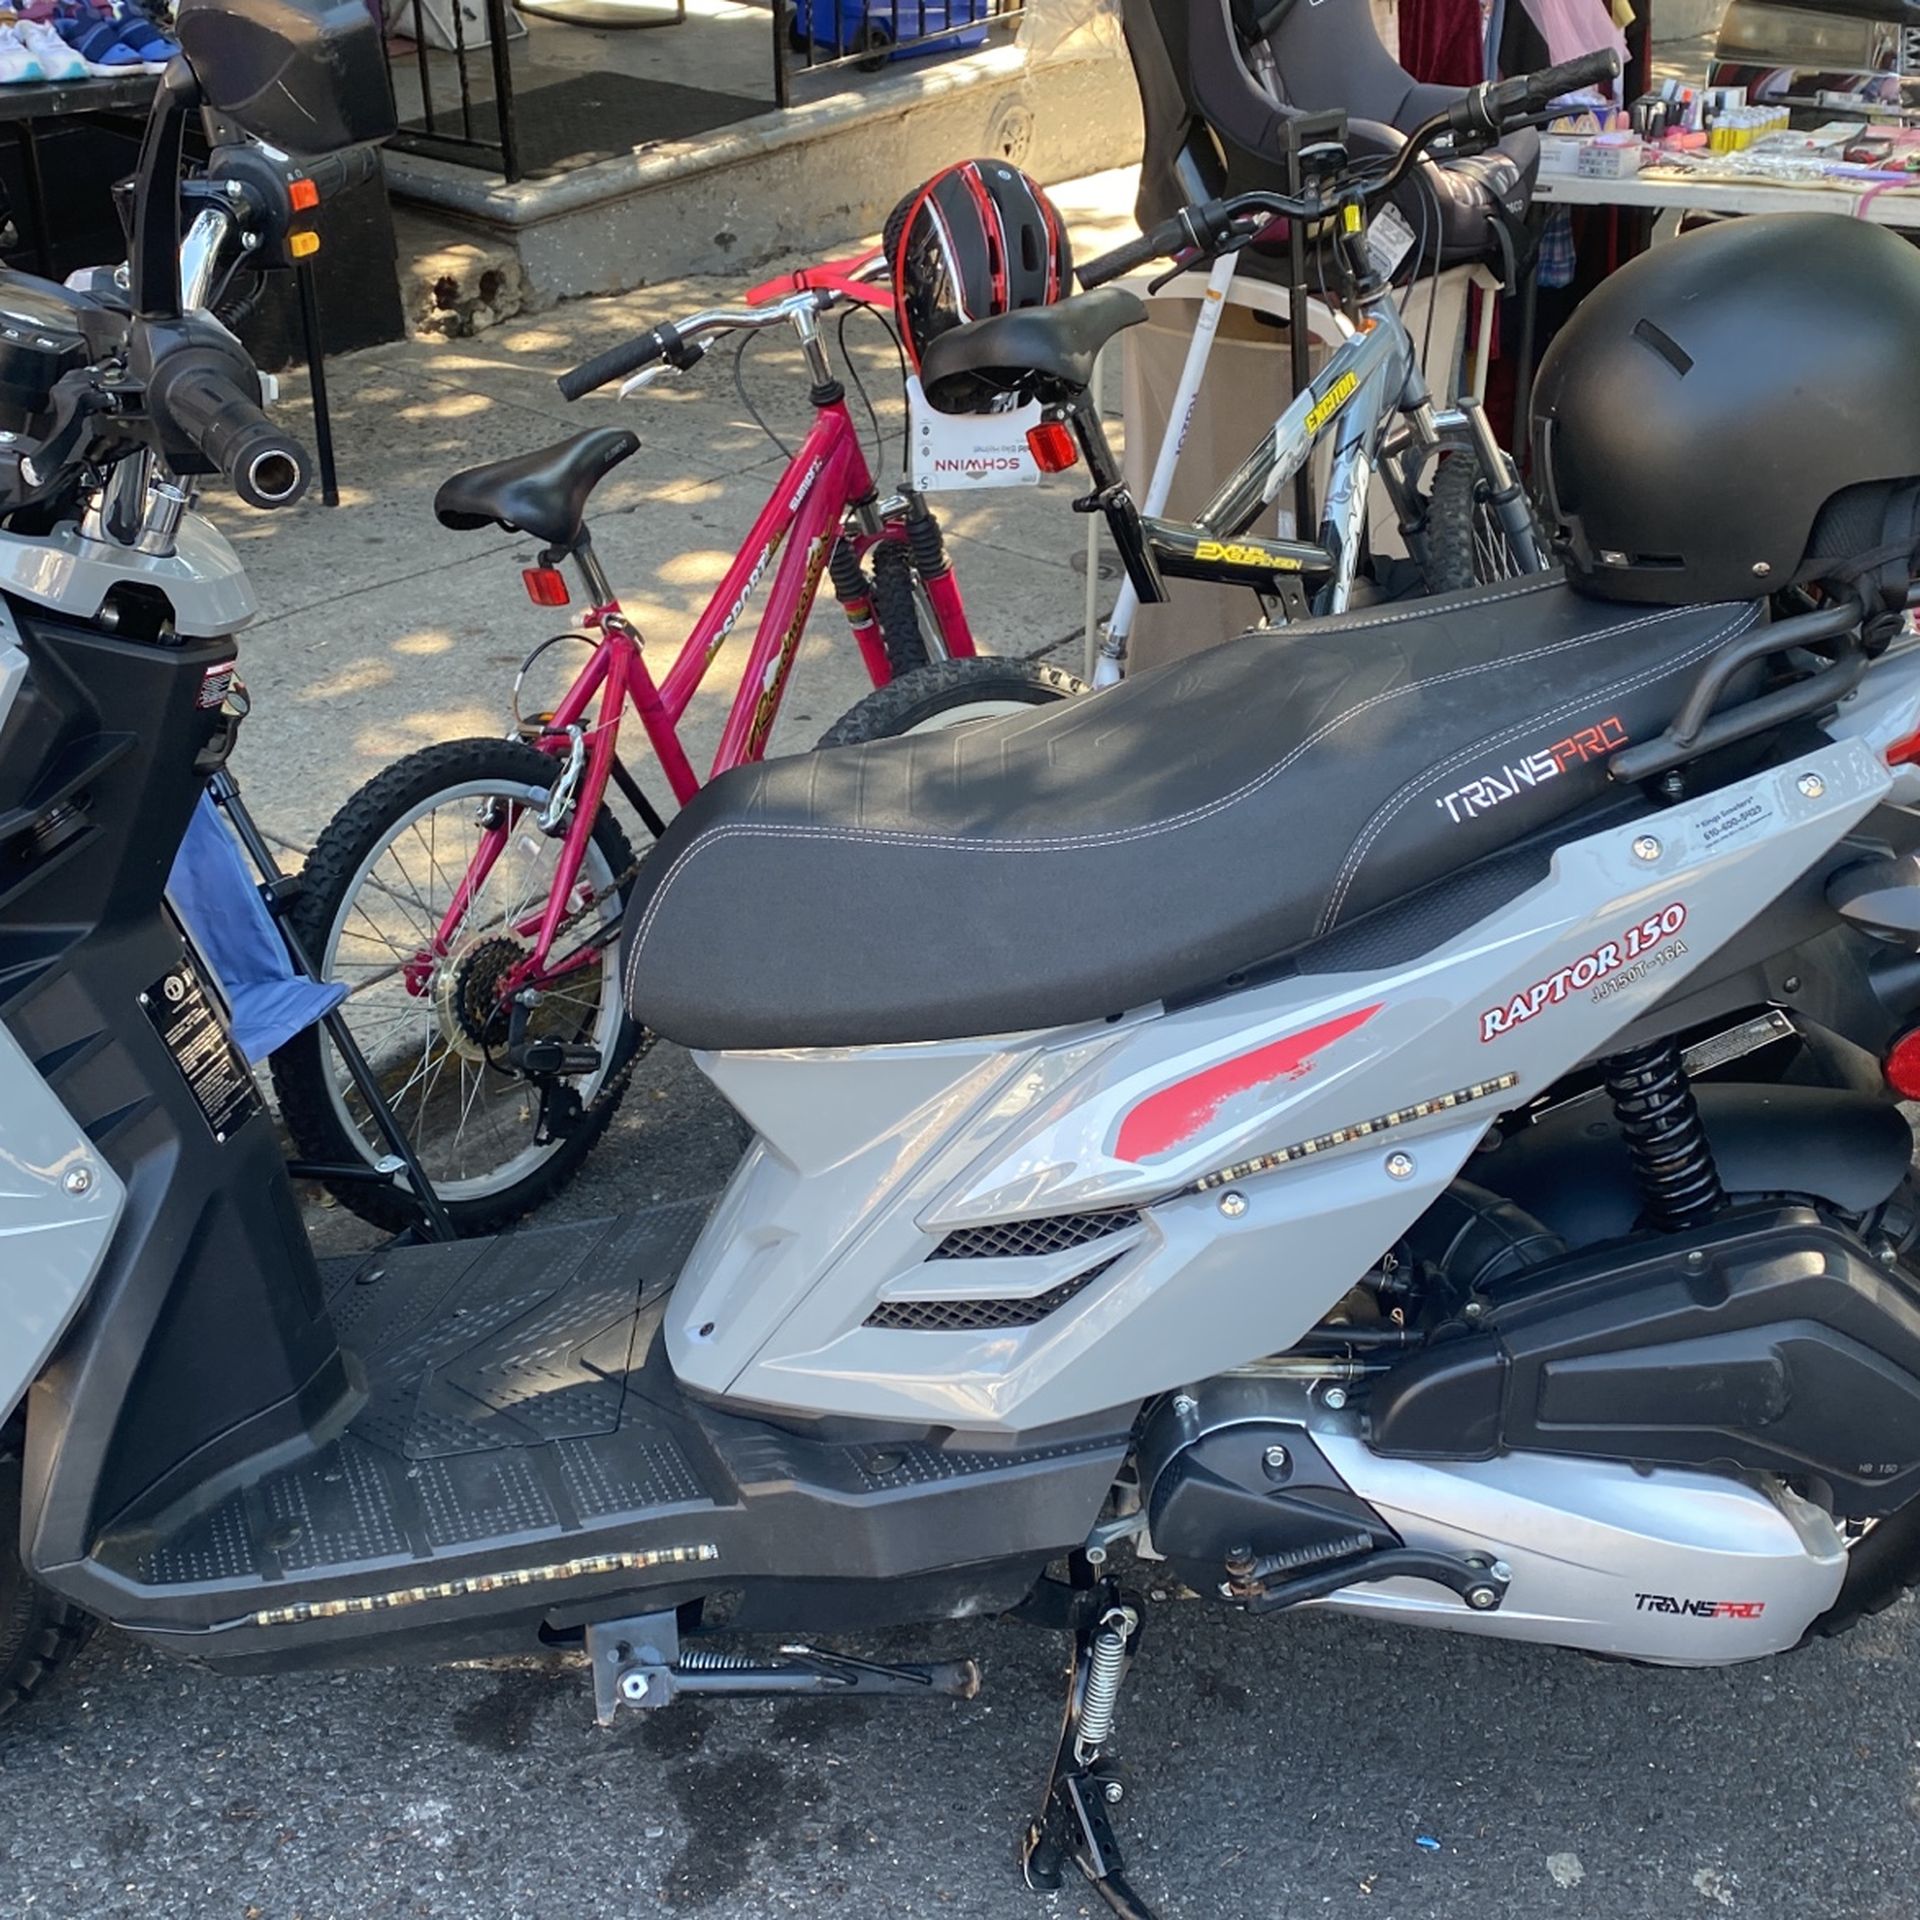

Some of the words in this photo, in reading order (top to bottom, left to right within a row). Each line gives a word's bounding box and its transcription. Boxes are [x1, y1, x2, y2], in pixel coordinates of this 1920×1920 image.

[935, 457, 1021, 472] SCHWINN
[722, 548, 771, 635] SPORT
[1435, 716, 1630, 824] TRANSPRO
[1480, 941, 1623, 1043] RAPTOR
[1624, 902, 1688, 961] 150
[1591, 940, 1689, 1004] JJ150T-16A
[1634, 1593, 1766, 1620] TRANSPRO
